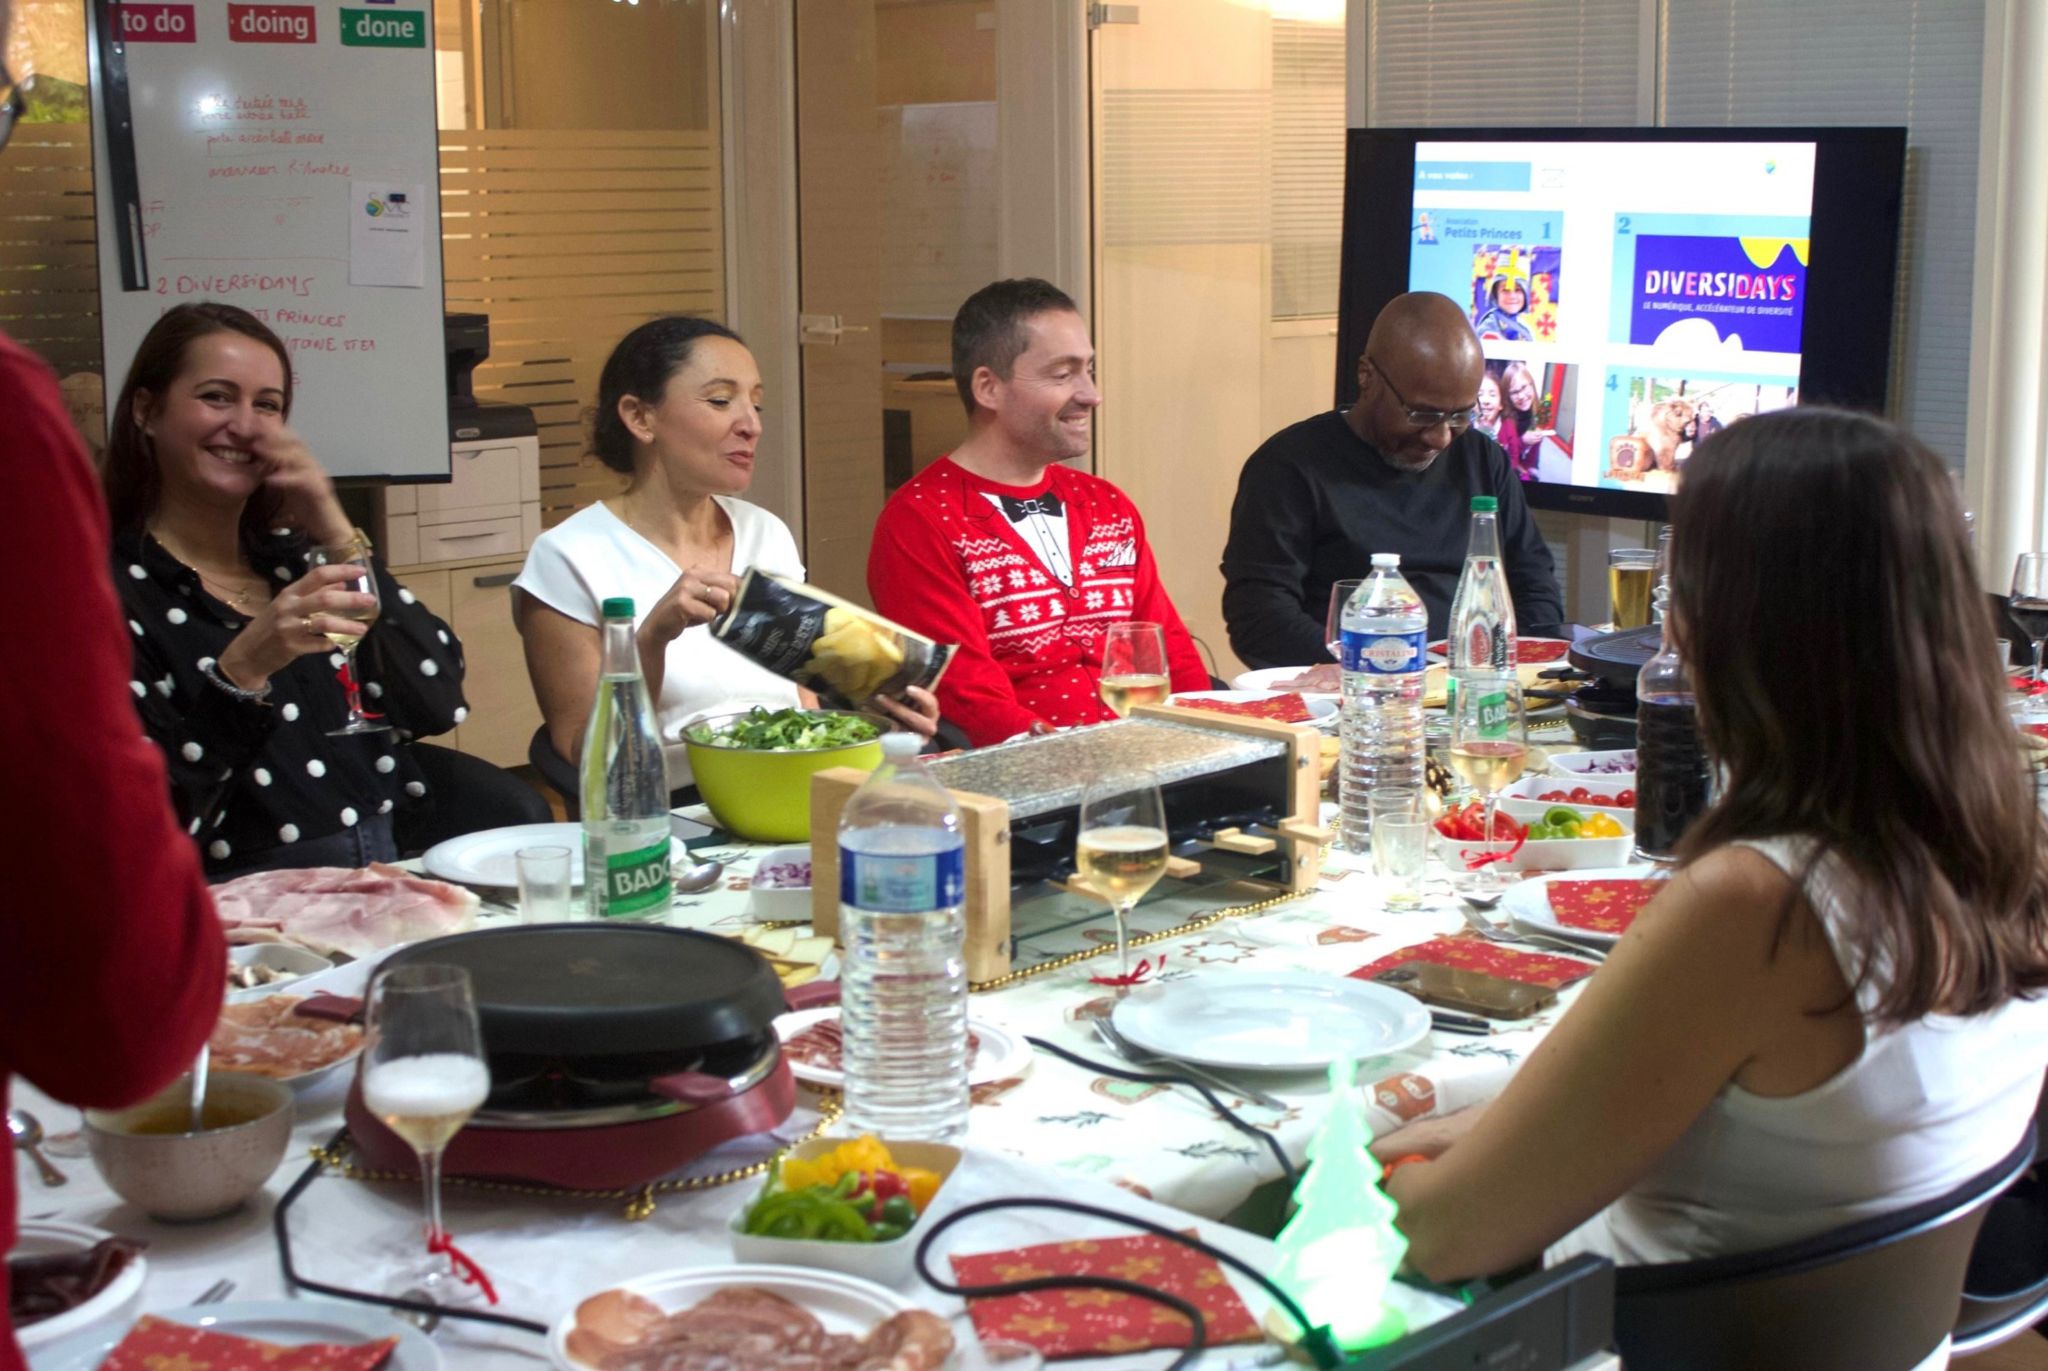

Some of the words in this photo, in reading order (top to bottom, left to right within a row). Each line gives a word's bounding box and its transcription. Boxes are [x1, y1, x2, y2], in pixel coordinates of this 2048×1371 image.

[122, 11, 147, 32] to
[154, 8, 186, 32] do
[240, 9, 308, 40] doing
[356, 13, 415, 38] done
[1444, 226, 1478, 239] Petits
[1480, 228, 1523, 240] Princes
[1542, 221, 1552, 240] 1
[1617, 216, 1632, 235] 2
[156, 277, 168, 294] 2
[1645, 269, 1797, 301] DIVERSIDAYS
[1605, 374, 1618, 392] 4
